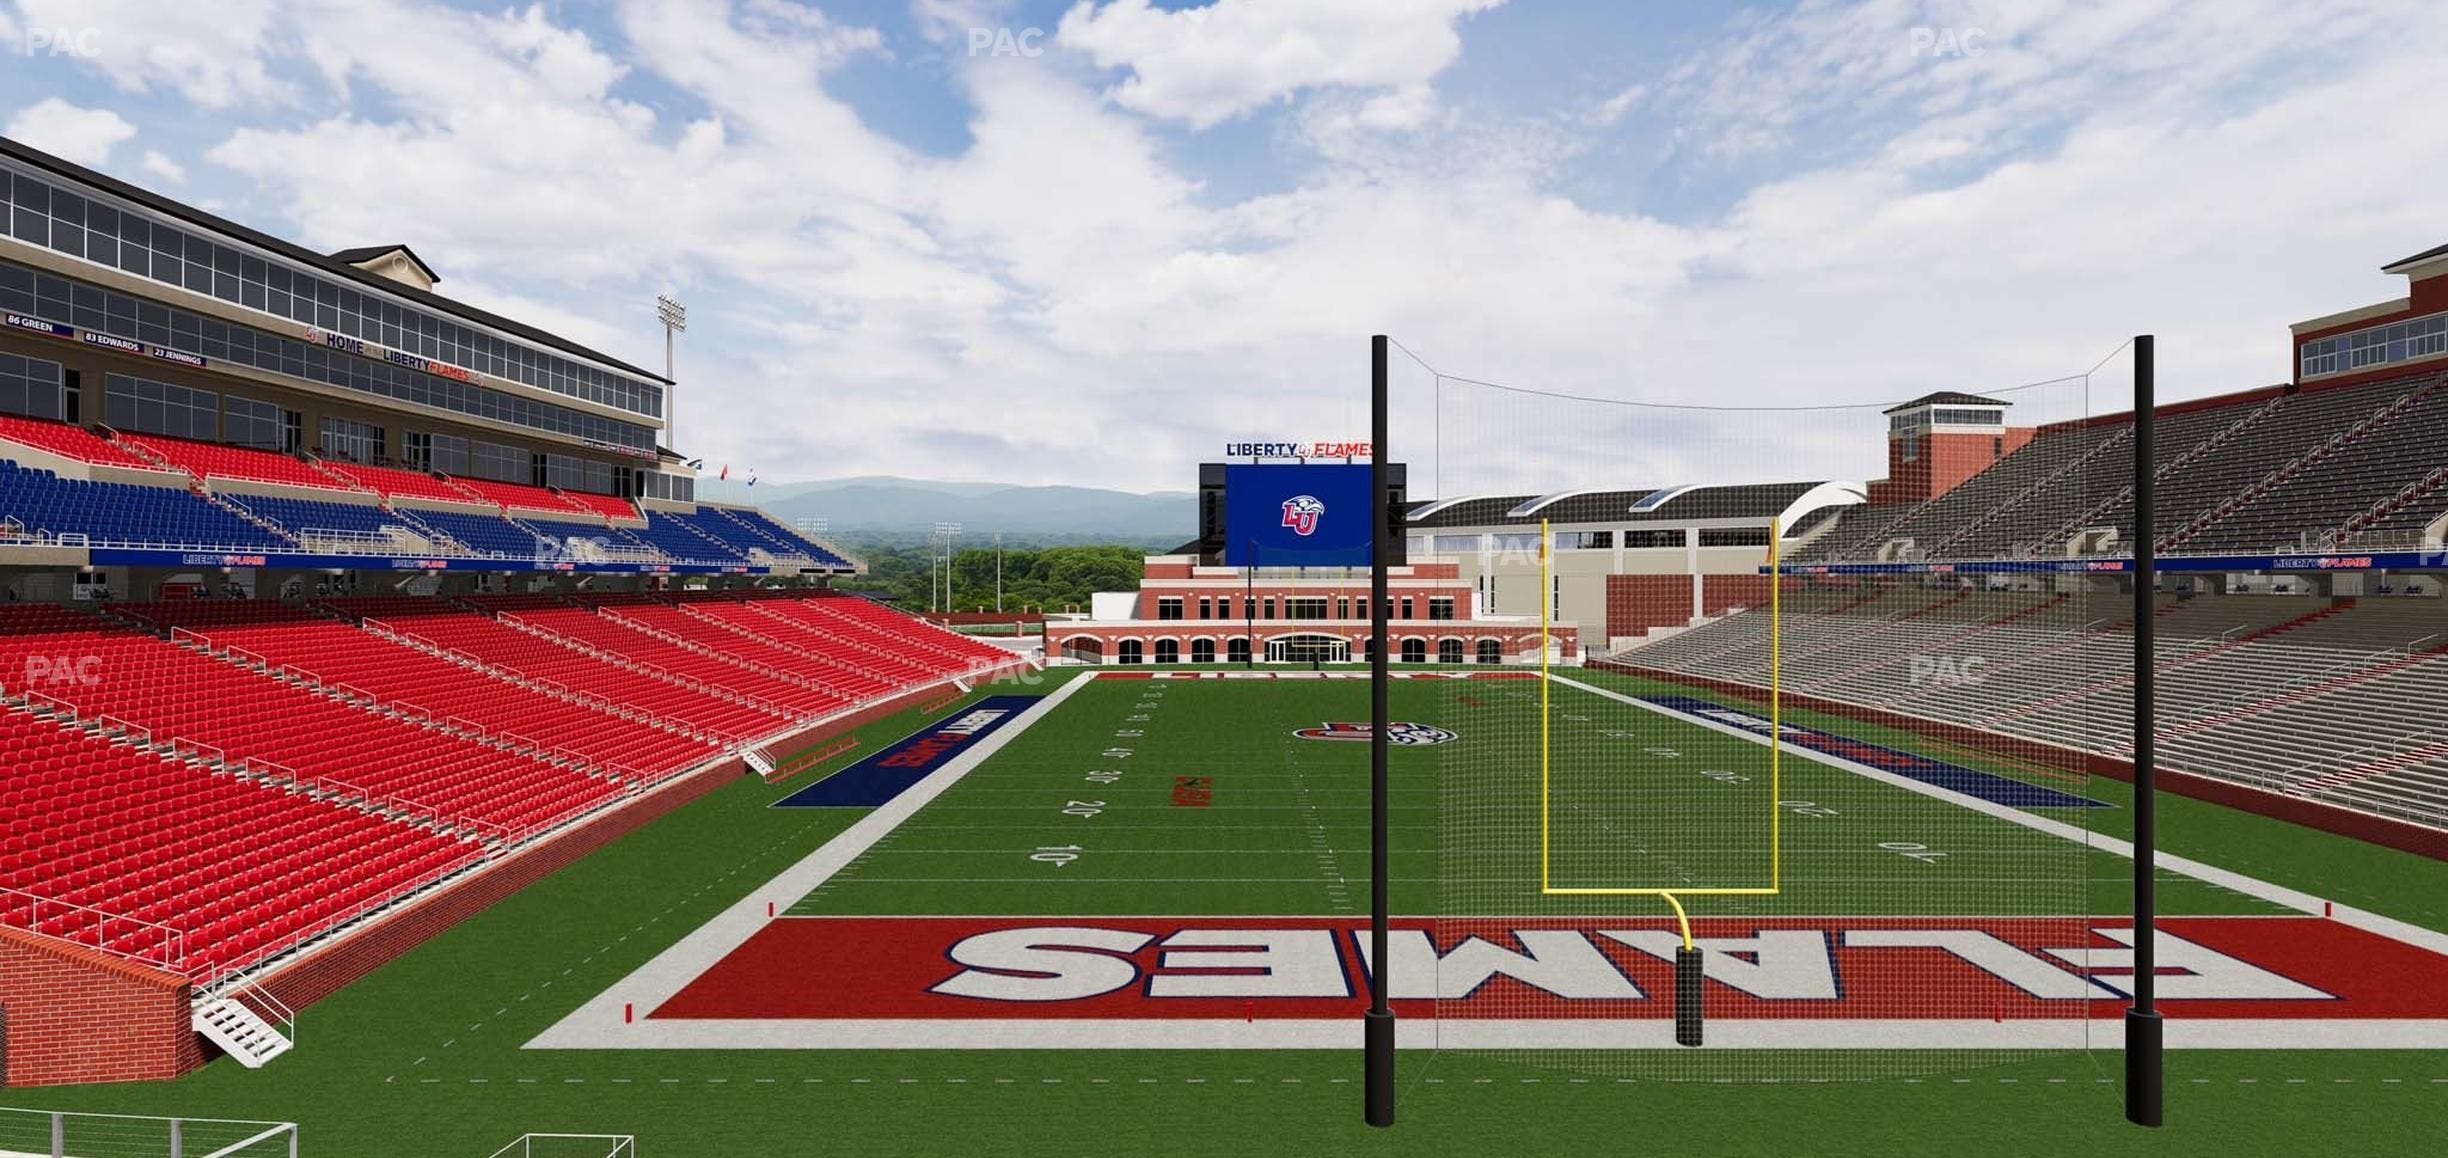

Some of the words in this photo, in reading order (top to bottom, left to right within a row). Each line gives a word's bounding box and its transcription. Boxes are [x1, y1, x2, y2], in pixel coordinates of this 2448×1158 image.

[7, 314, 20, 325] 86
[21, 318, 53, 332] GREEN
[85, 332, 97, 342] 83
[97, 335, 140, 352] EDWARDS
[326, 332, 364, 354] HOME
[154, 348, 165, 358] 23
[164, 350, 202, 366] JENNINGS
[1226, 443, 1298, 457] LIBERTY
[1060, 800, 1108, 815] 20
[1029, 845, 1083, 862] 10
[922, 926, 2348, 1001] FLAMES
